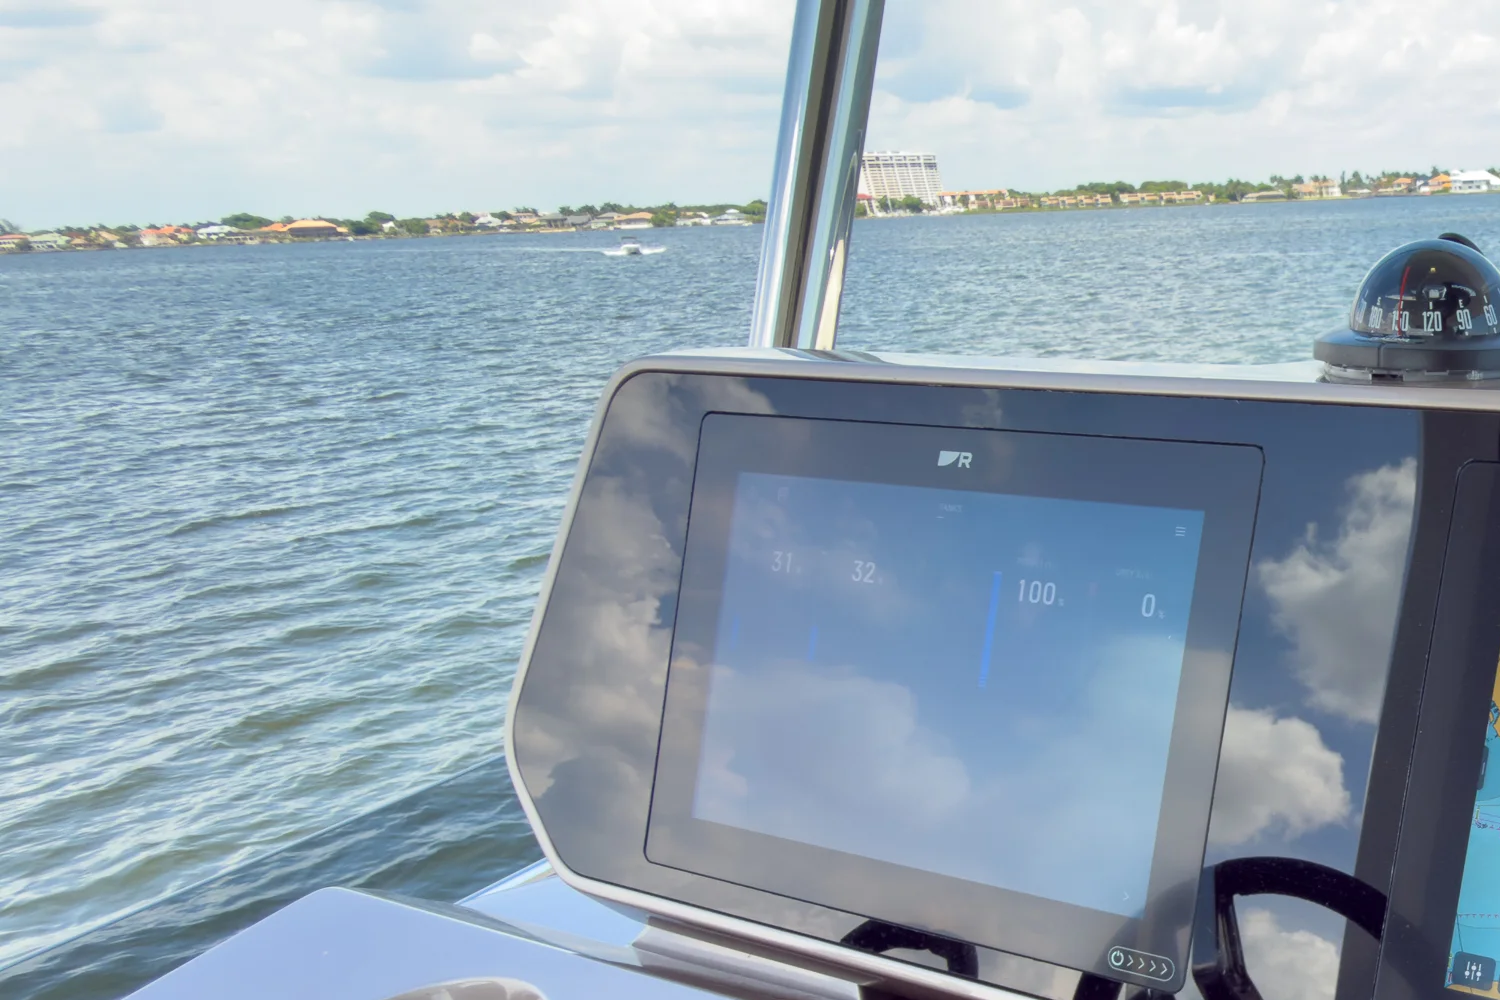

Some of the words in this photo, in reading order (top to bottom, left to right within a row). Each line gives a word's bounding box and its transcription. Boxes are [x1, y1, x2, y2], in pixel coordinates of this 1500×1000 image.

[1459, 299, 1464, 308] E
[1422, 311, 1442, 332] 120
[1456, 309, 1472, 330] 90
[1484, 304, 1498, 326] 60
[771, 551, 793, 574] 31
[851, 559, 876, 584] 32
[1018, 579, 1057, 606] 100
[1141, 593, 1156, 618] 0
